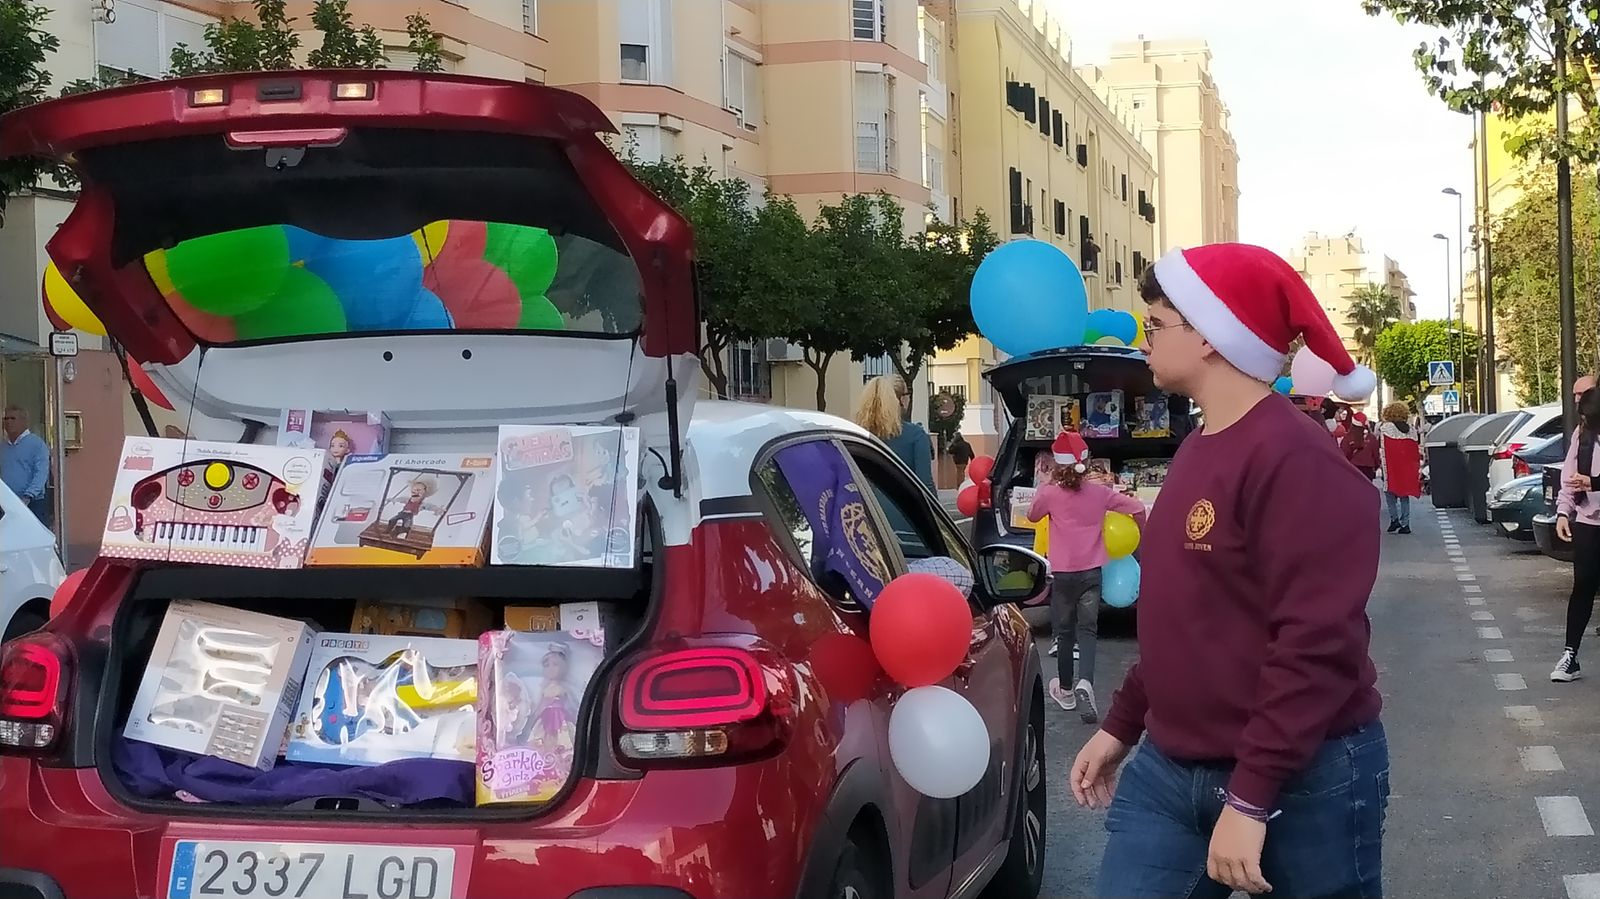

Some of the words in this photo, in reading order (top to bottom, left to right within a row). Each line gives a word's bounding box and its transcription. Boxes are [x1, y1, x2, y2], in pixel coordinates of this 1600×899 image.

[482, 752, 543, 782] Sarkle
[176, 877, 187, 890] E
[200, 850, 325, 898] 2337
[342, 854, 439, 899] LGD
